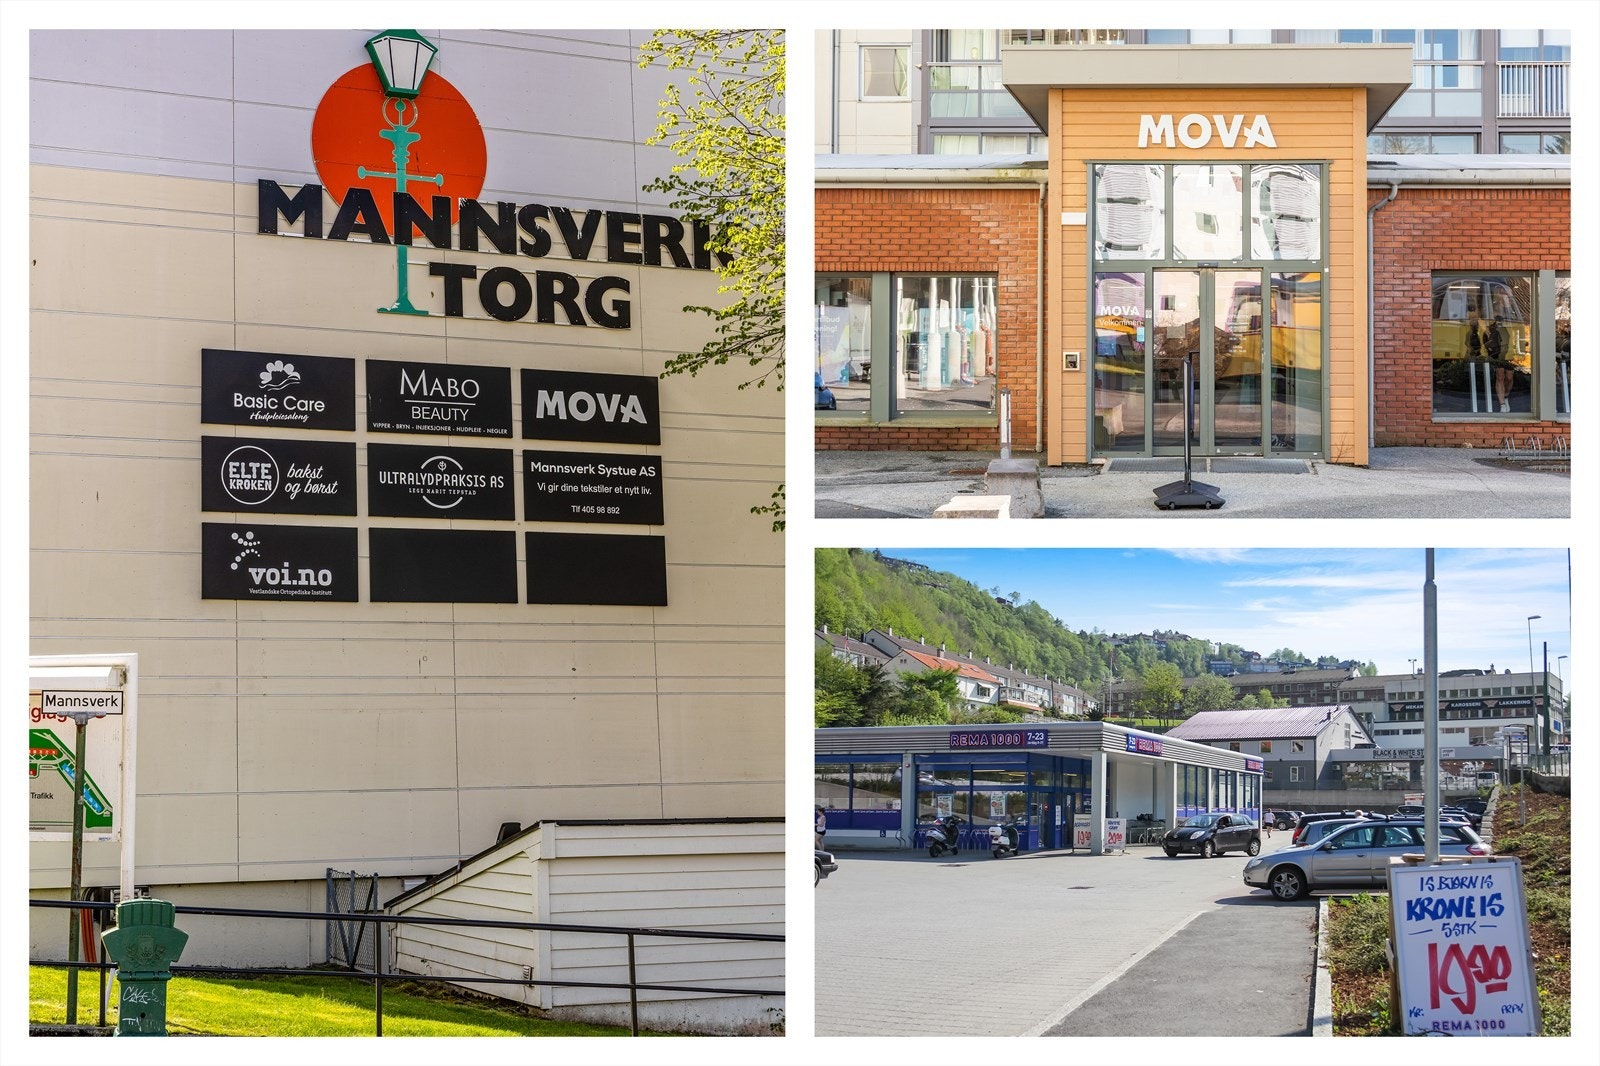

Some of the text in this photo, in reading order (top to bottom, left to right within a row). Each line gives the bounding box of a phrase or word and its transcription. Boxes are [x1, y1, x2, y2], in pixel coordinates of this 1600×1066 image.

[1137, 113, 1278, 149] MOVA
[429, 262, 631, 329] TORG
[1100, 306, 1140, 316] MOVA
[400, 367, 480, 399] MABO
[233, 392, 326, 412] Basic Care
[535, 389, 648, 424] MOVA
[411, 406, 470, 421] BEAUTY
[415, 424, 452, 432] INJEKSJONER
[228, 461, 273, 480] ELTE
[286, 463, 324, 479] bakst
[530, 461, 656, 478] Mannsverk Systue AS
[229, 479, 272, 491] KROKEN
[379, 471, 505, 489] ULTRALYDPRAKSIS AS
[284, 478, 339, 500] og børst
[537, 482, 652, 496] Vi gir dine tekstiler et nytt liv.
[571, 505, 620, 515] Tlf 405 98 892
[248, 561, 333, 587] voi.no
[280, 588, 311, 596] Ortopediske
[45, 694, 119, 707] Mannsverk
[950, 733, 1021, 746] REMA 1000
[1027, 732, 1044, 741] 7-23
[31, 792, 54, 800] Trafikk
[1432, 1019, 1506, 1032] REMA 1000
